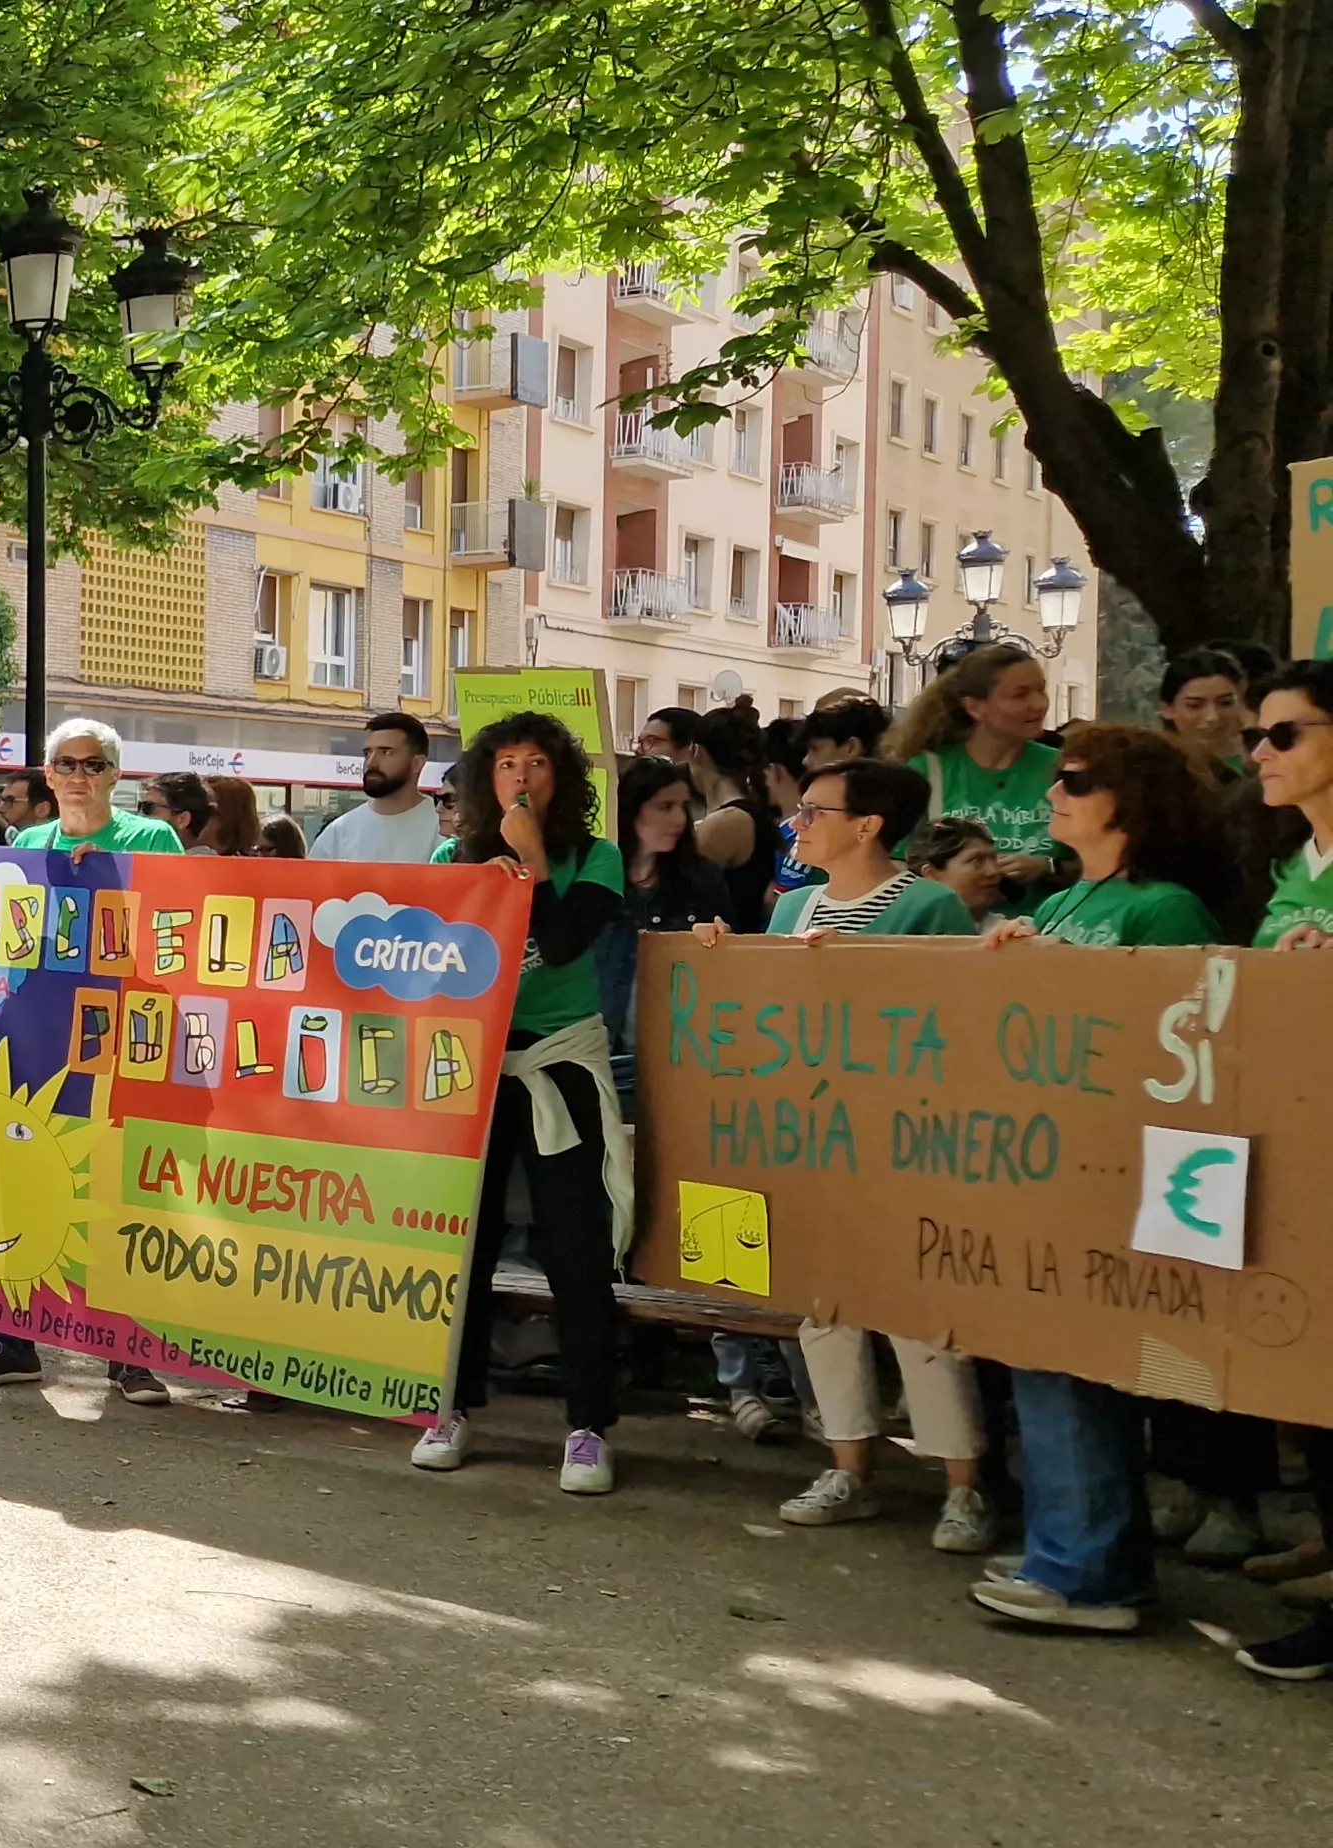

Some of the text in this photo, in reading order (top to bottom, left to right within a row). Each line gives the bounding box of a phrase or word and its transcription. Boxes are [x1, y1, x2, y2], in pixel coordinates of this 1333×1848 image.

[464, 690, 522, 707] Presupuesto
[188, 751, 224, 770] iberCaja
[335, 760, 364, 776] iberCaj
[354, 935, 467, 973] CRÍTICA
[80, 997, 474, 1102] PÚBLICA
[669, 960, 949, 1083] RESULTA
[996, 1001, 1123, 1096] QUE
[708, 1079, 858, 1175] HABÍA
[138, 1144, 184, 1196] LA
[196, 1153, 376, 1226] NUESTRA
[117, 1222, 459, 1327] TODOS PINTAMOS
[918, 1216, 1207, 1324] PARA LA PRIVADA
[11, 1306, 33, 1330] en
[39, 1305, 116, 1349] Defensa
[126, 1327, 152, 1358] de
[161, 1331, 180, 1363] la
[189, 1337, 275, 1381] Escuela
[282, 1355, 372, 1401] Pública
[381, 1376, 441, 1414] HUES
